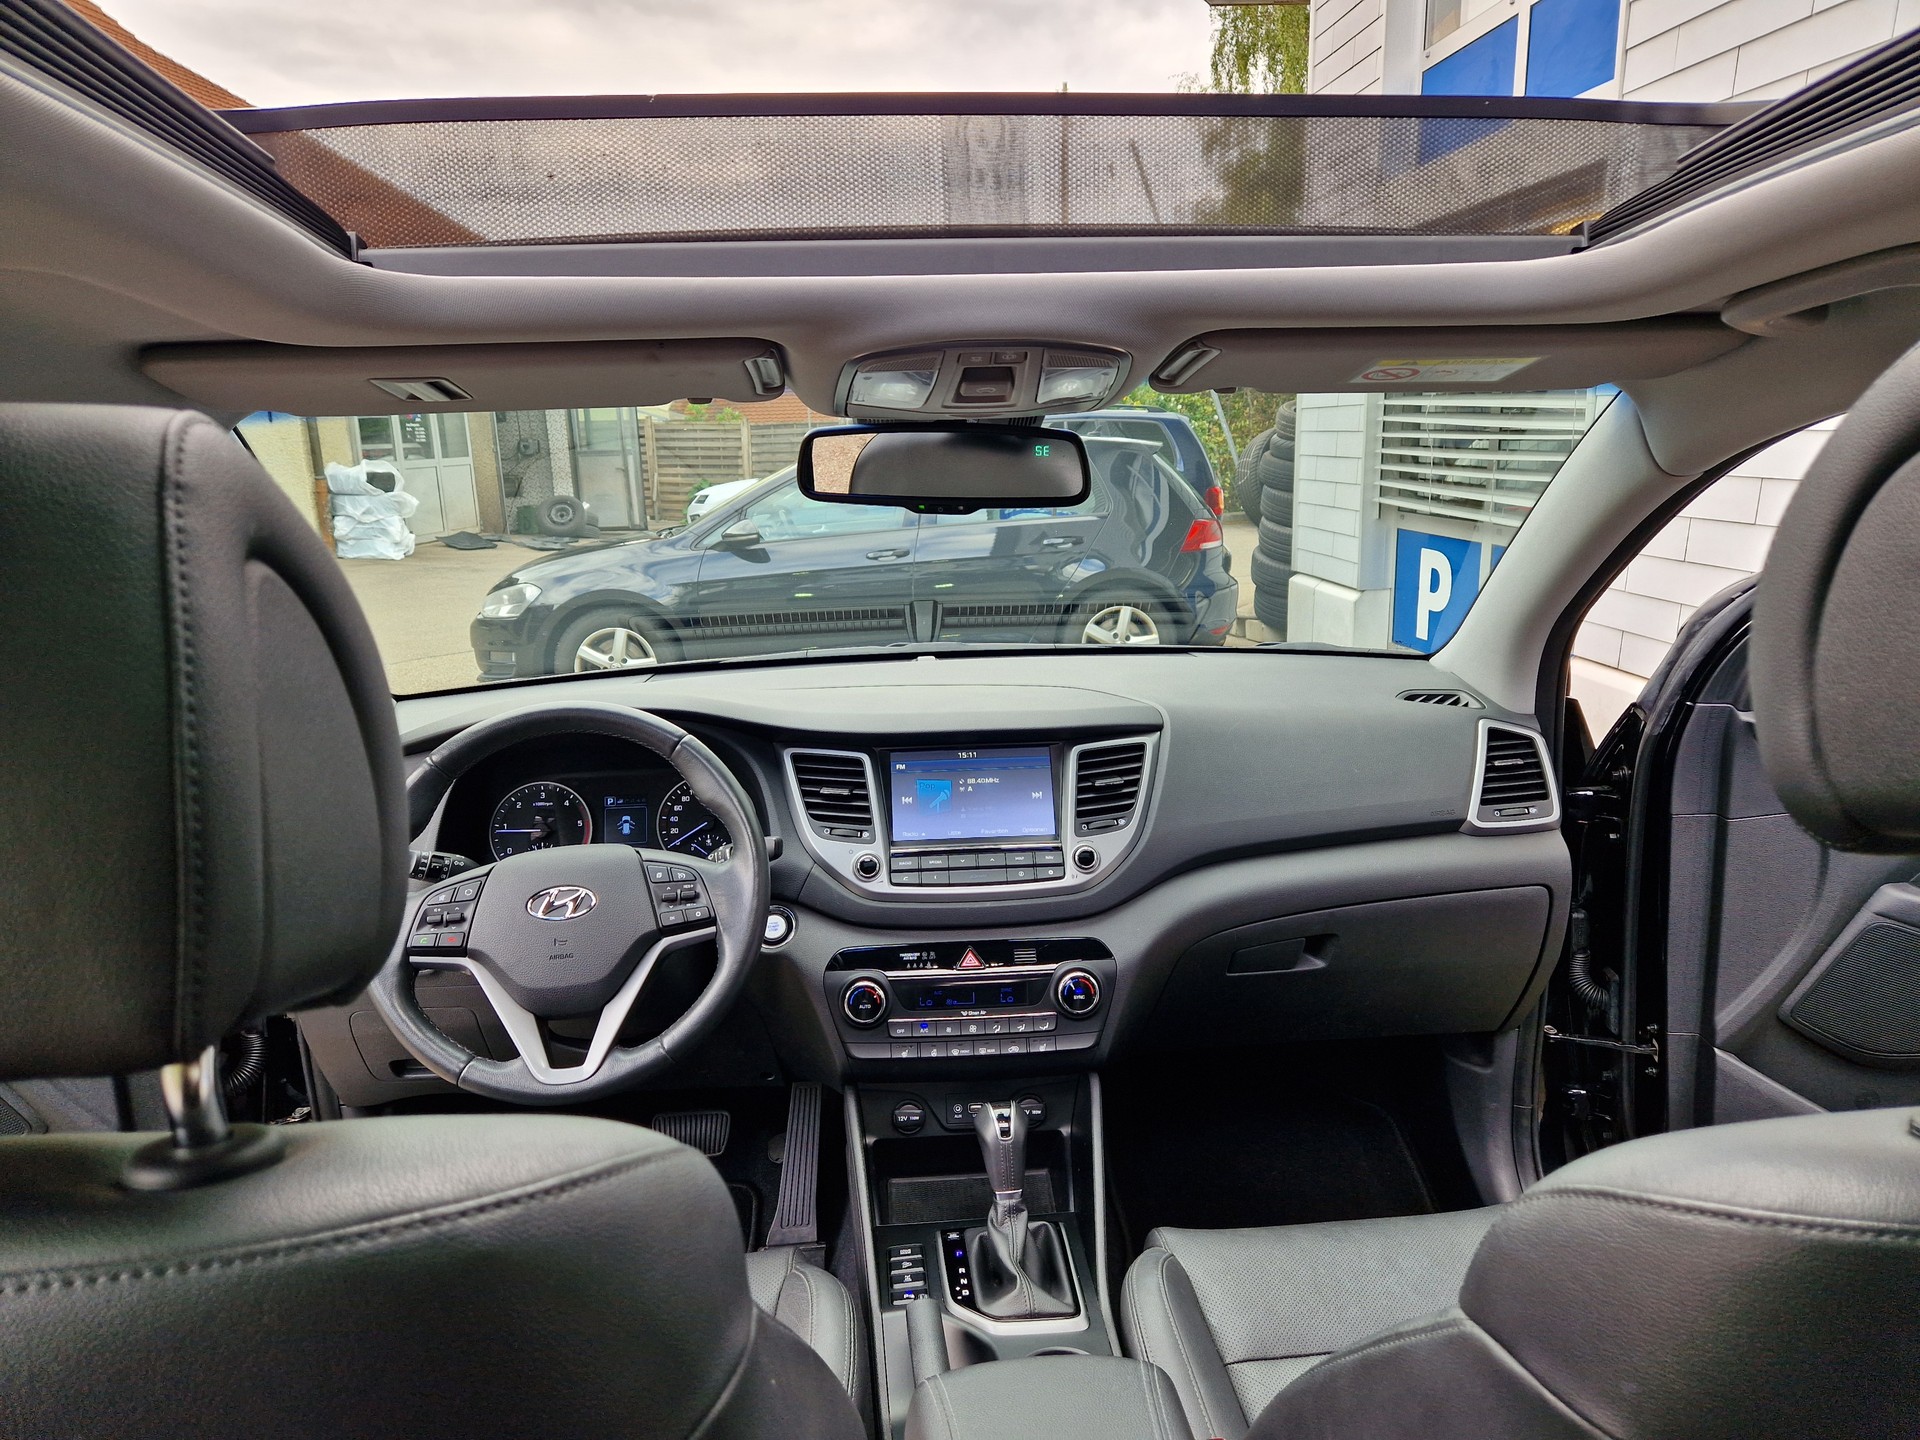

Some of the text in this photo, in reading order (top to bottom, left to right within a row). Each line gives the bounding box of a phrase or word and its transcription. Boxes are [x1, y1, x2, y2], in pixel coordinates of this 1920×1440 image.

[1035, 445, 1050, 457] SE
[1415, 547, 1453, 641] P
[919, 782, 936, 790] Pop
[540, 791, 546, 799] 3
[516, 801, 522, 809] 2
[607, 798, 614, 806] P
[506, 847, 513, 855] 0
